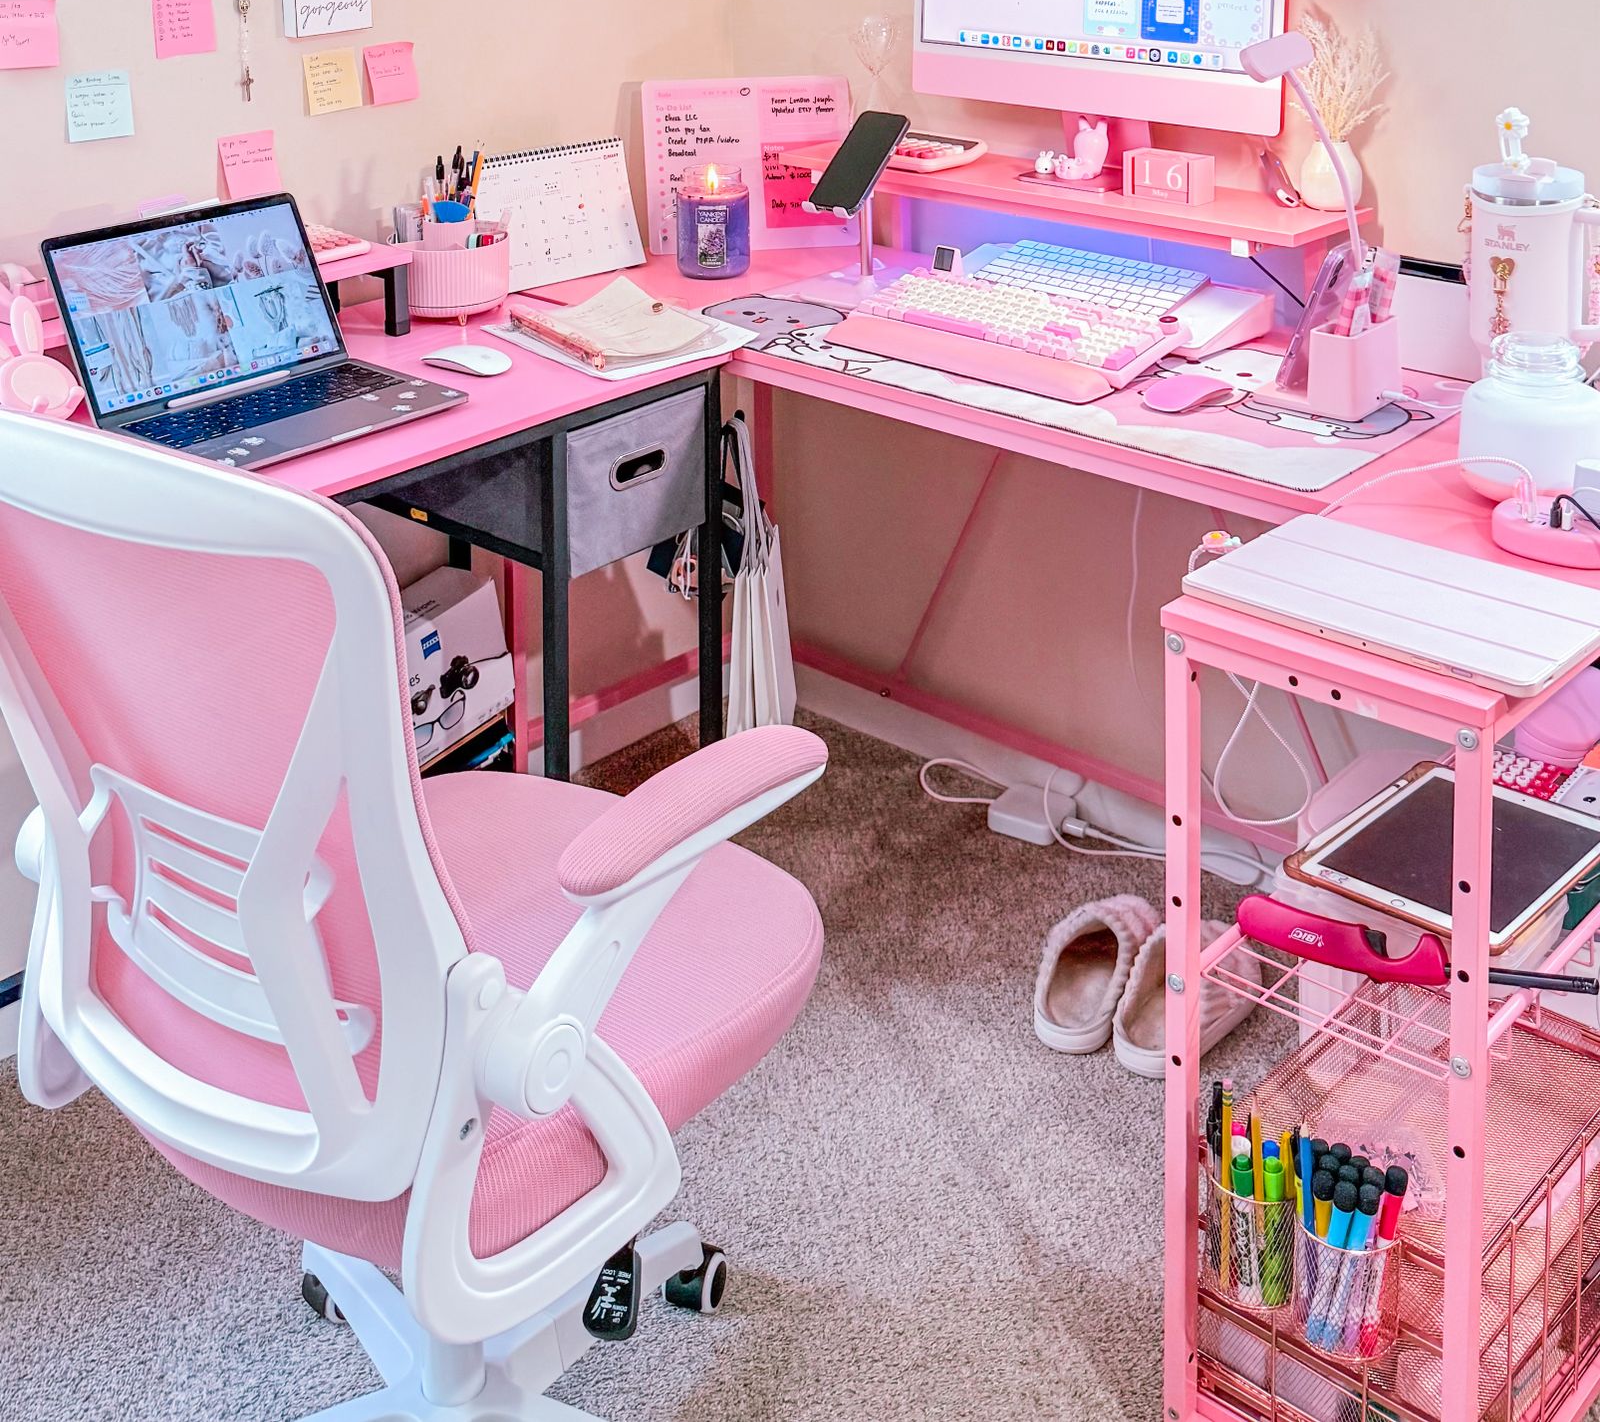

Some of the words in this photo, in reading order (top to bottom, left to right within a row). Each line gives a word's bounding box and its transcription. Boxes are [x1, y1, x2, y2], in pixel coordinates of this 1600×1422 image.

[668, 137, 686, 145] Create
[668, 149, 696, 157] Broadcast
[1484, 238, 1530, 251] STANLEY
[1293, 930, 1316, 943] BIC
